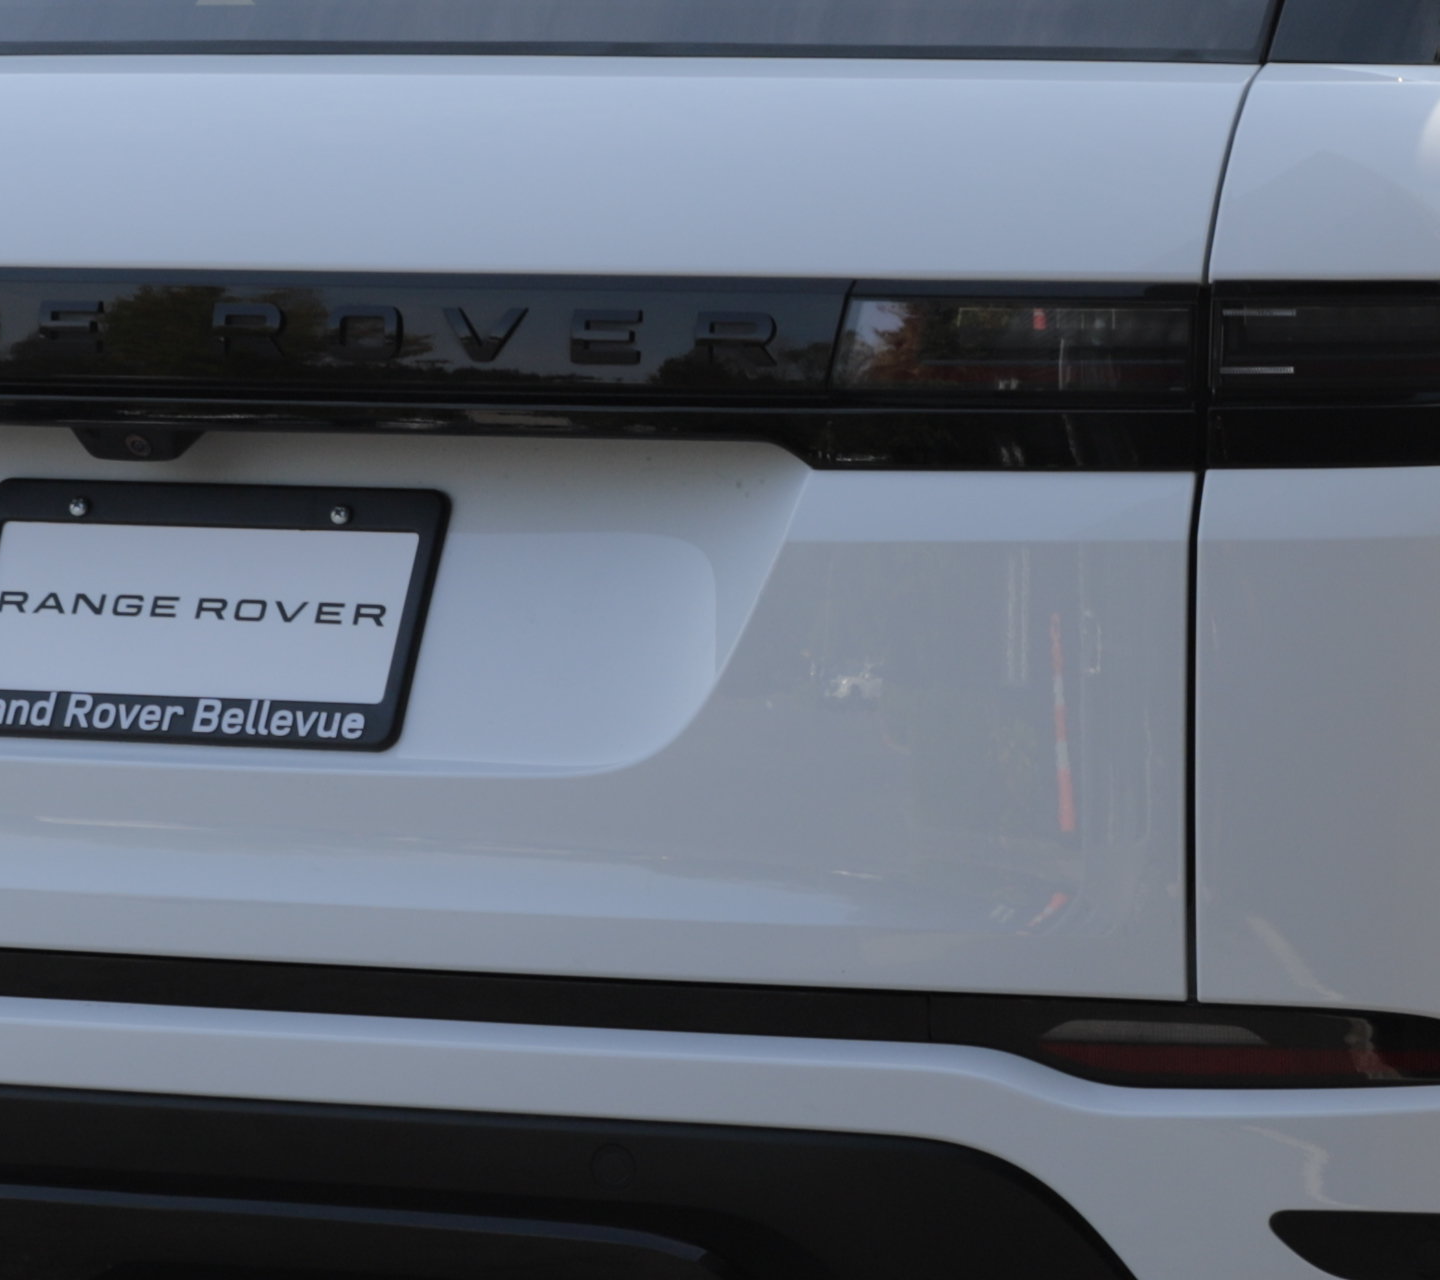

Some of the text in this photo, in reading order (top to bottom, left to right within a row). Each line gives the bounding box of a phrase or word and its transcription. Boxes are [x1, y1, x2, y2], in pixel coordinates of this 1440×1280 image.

[212, 301, 778, 368] ROVER
[194, 598, 387, 627] ROVER
[63, 693, 185, 732] Rover
[191, 698, 366, 740] Bellevue
